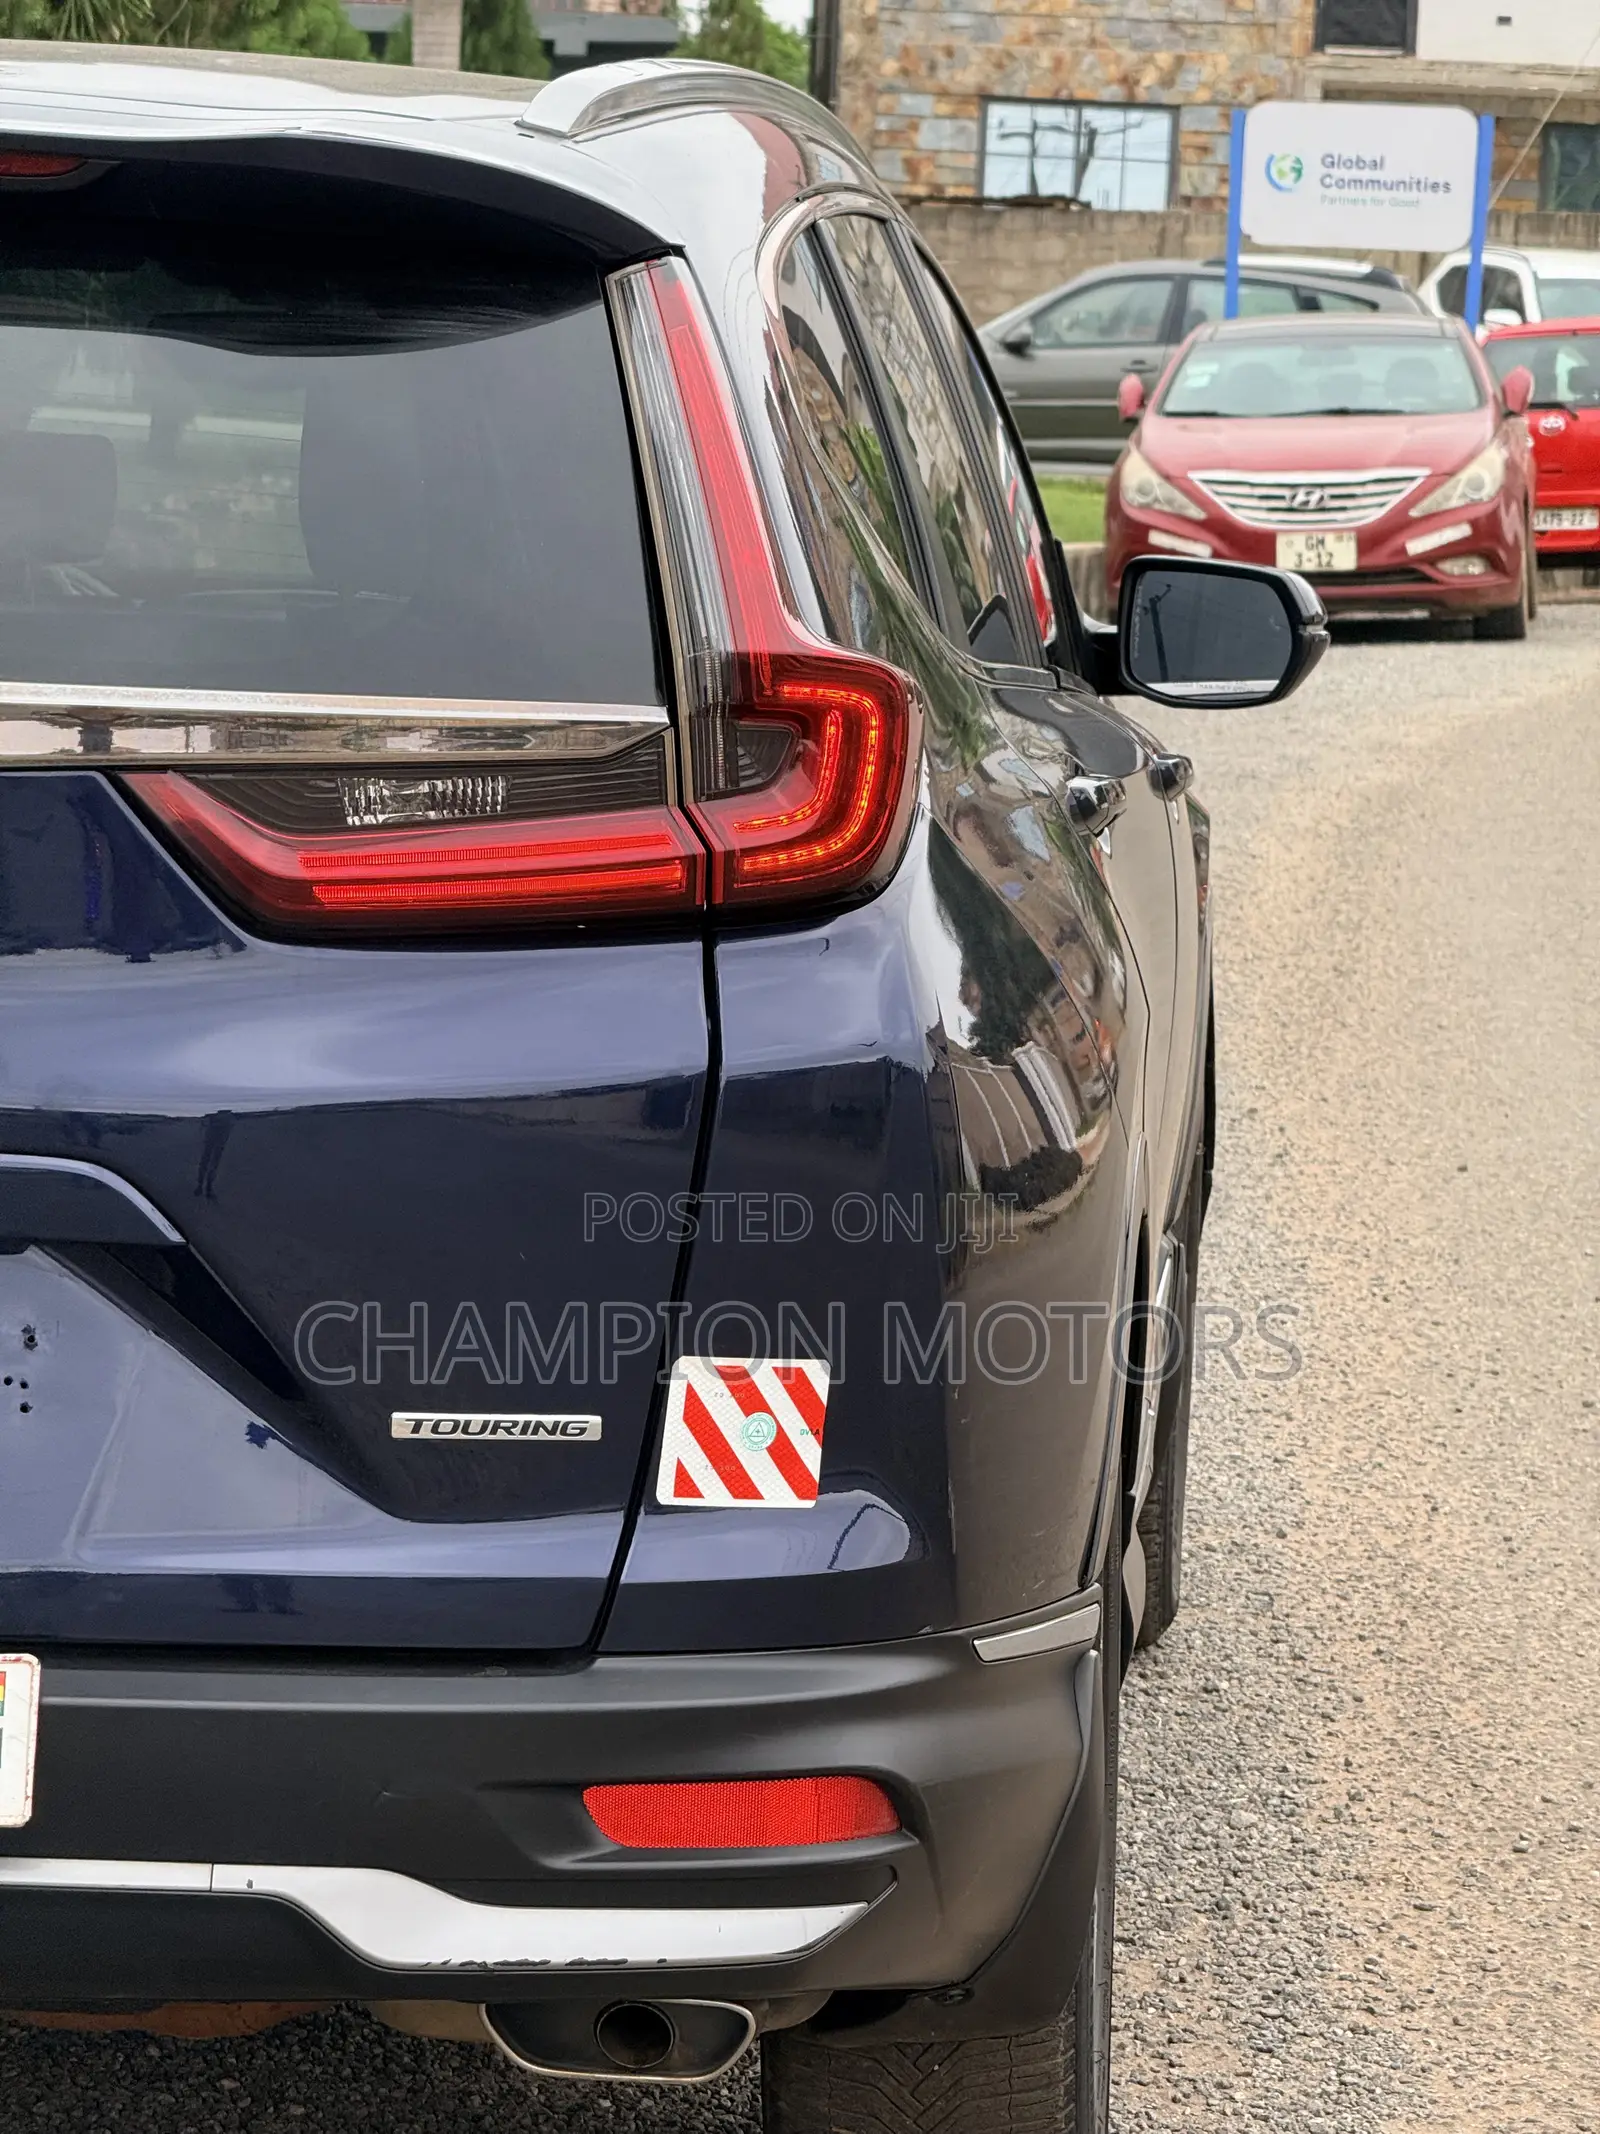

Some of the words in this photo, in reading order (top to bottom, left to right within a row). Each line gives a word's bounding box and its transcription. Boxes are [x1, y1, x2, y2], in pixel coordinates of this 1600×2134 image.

[1320, 153, 1385, 171] Global
[1319, 173, 1452, 194] Communities
[405, 1418, 590, 1437] TOURING
